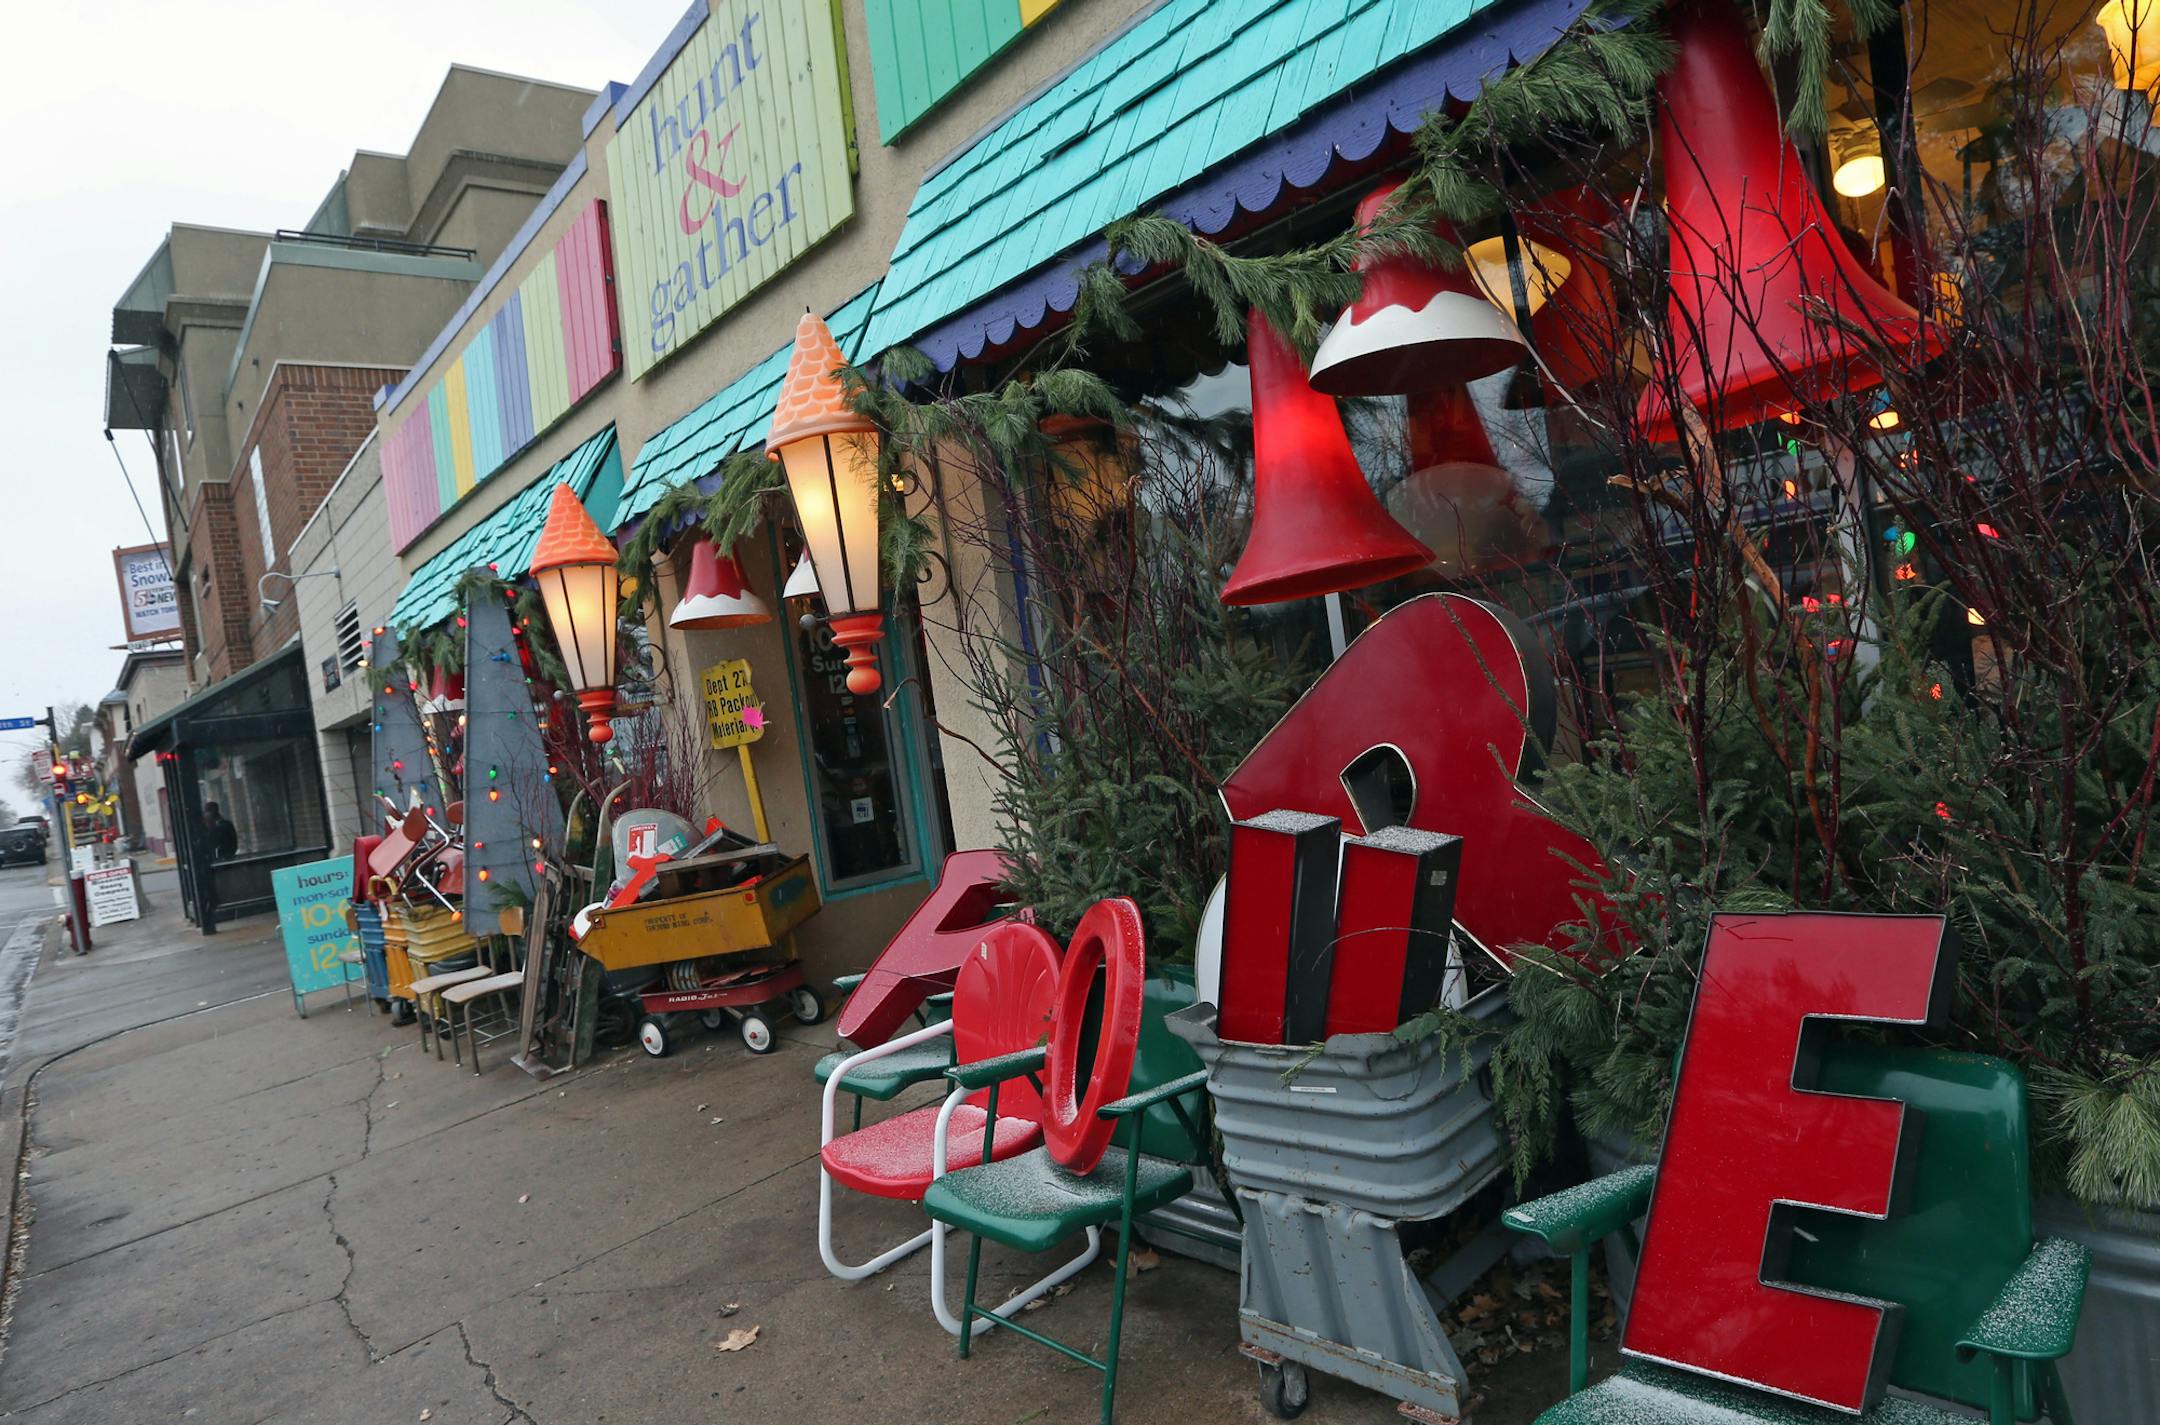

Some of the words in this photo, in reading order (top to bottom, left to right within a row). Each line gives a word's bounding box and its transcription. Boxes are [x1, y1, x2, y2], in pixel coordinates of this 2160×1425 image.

[648, 11, 763, 176] hunt
[679, 122, 748, 236] &
[650, 161, 802, 353] gather
[129, 562, 153, 574] Best
[705, 675, 728, 695] Dept
[828, 674, 848, 694] 12
[297, 871, 349, 889] hours:
[292, 886, 350, 906] mon-sat
[307, 927, 352, 944] sunda
[669, 995, 697, 1003] RADIO
[1618, 911, 1949, 1414] E
